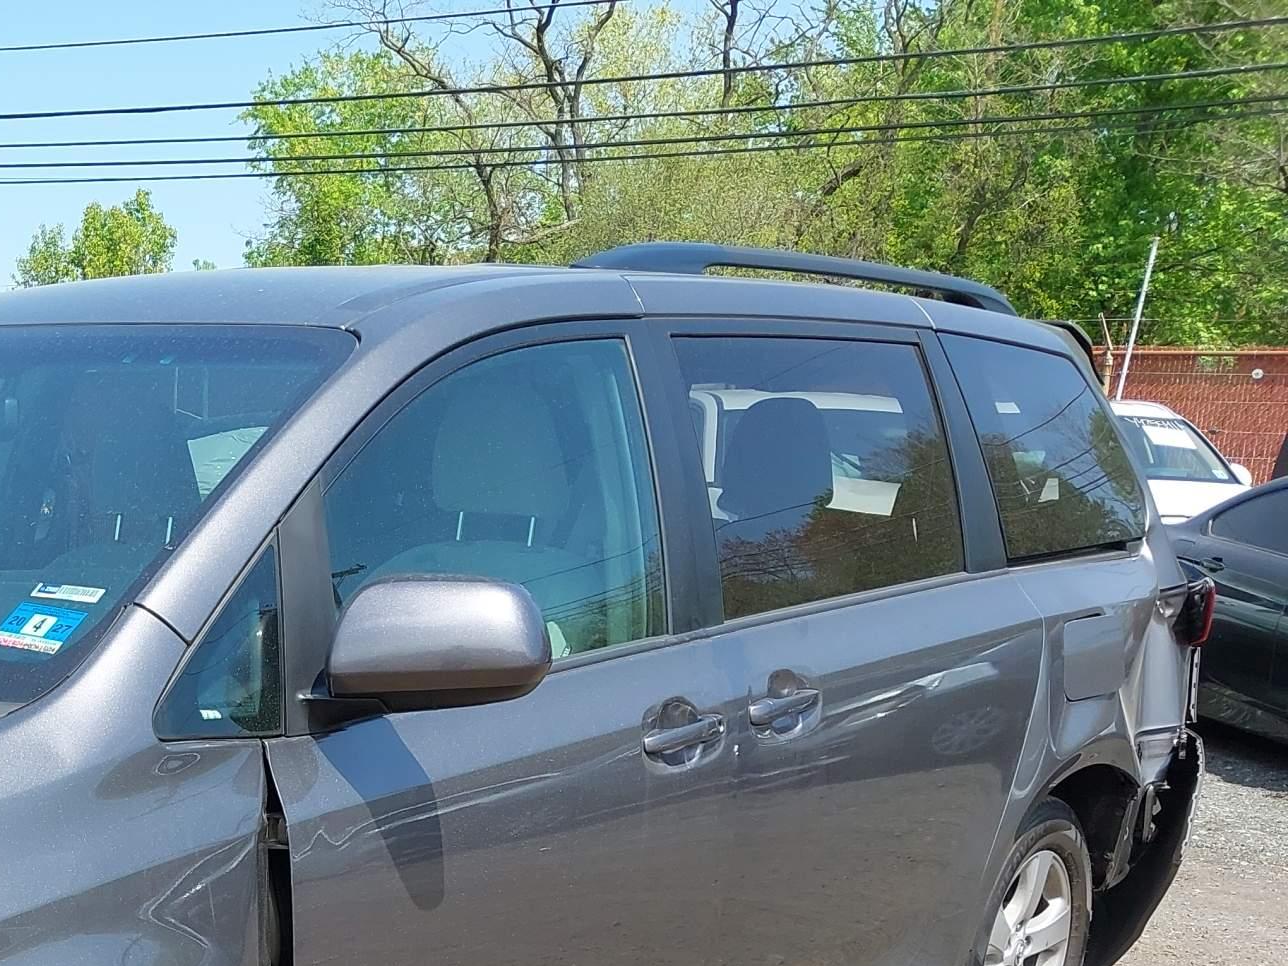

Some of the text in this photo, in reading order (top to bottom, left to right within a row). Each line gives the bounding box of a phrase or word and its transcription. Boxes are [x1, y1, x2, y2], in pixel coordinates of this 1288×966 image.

[8, 615, 72, 633] 20 4 27
